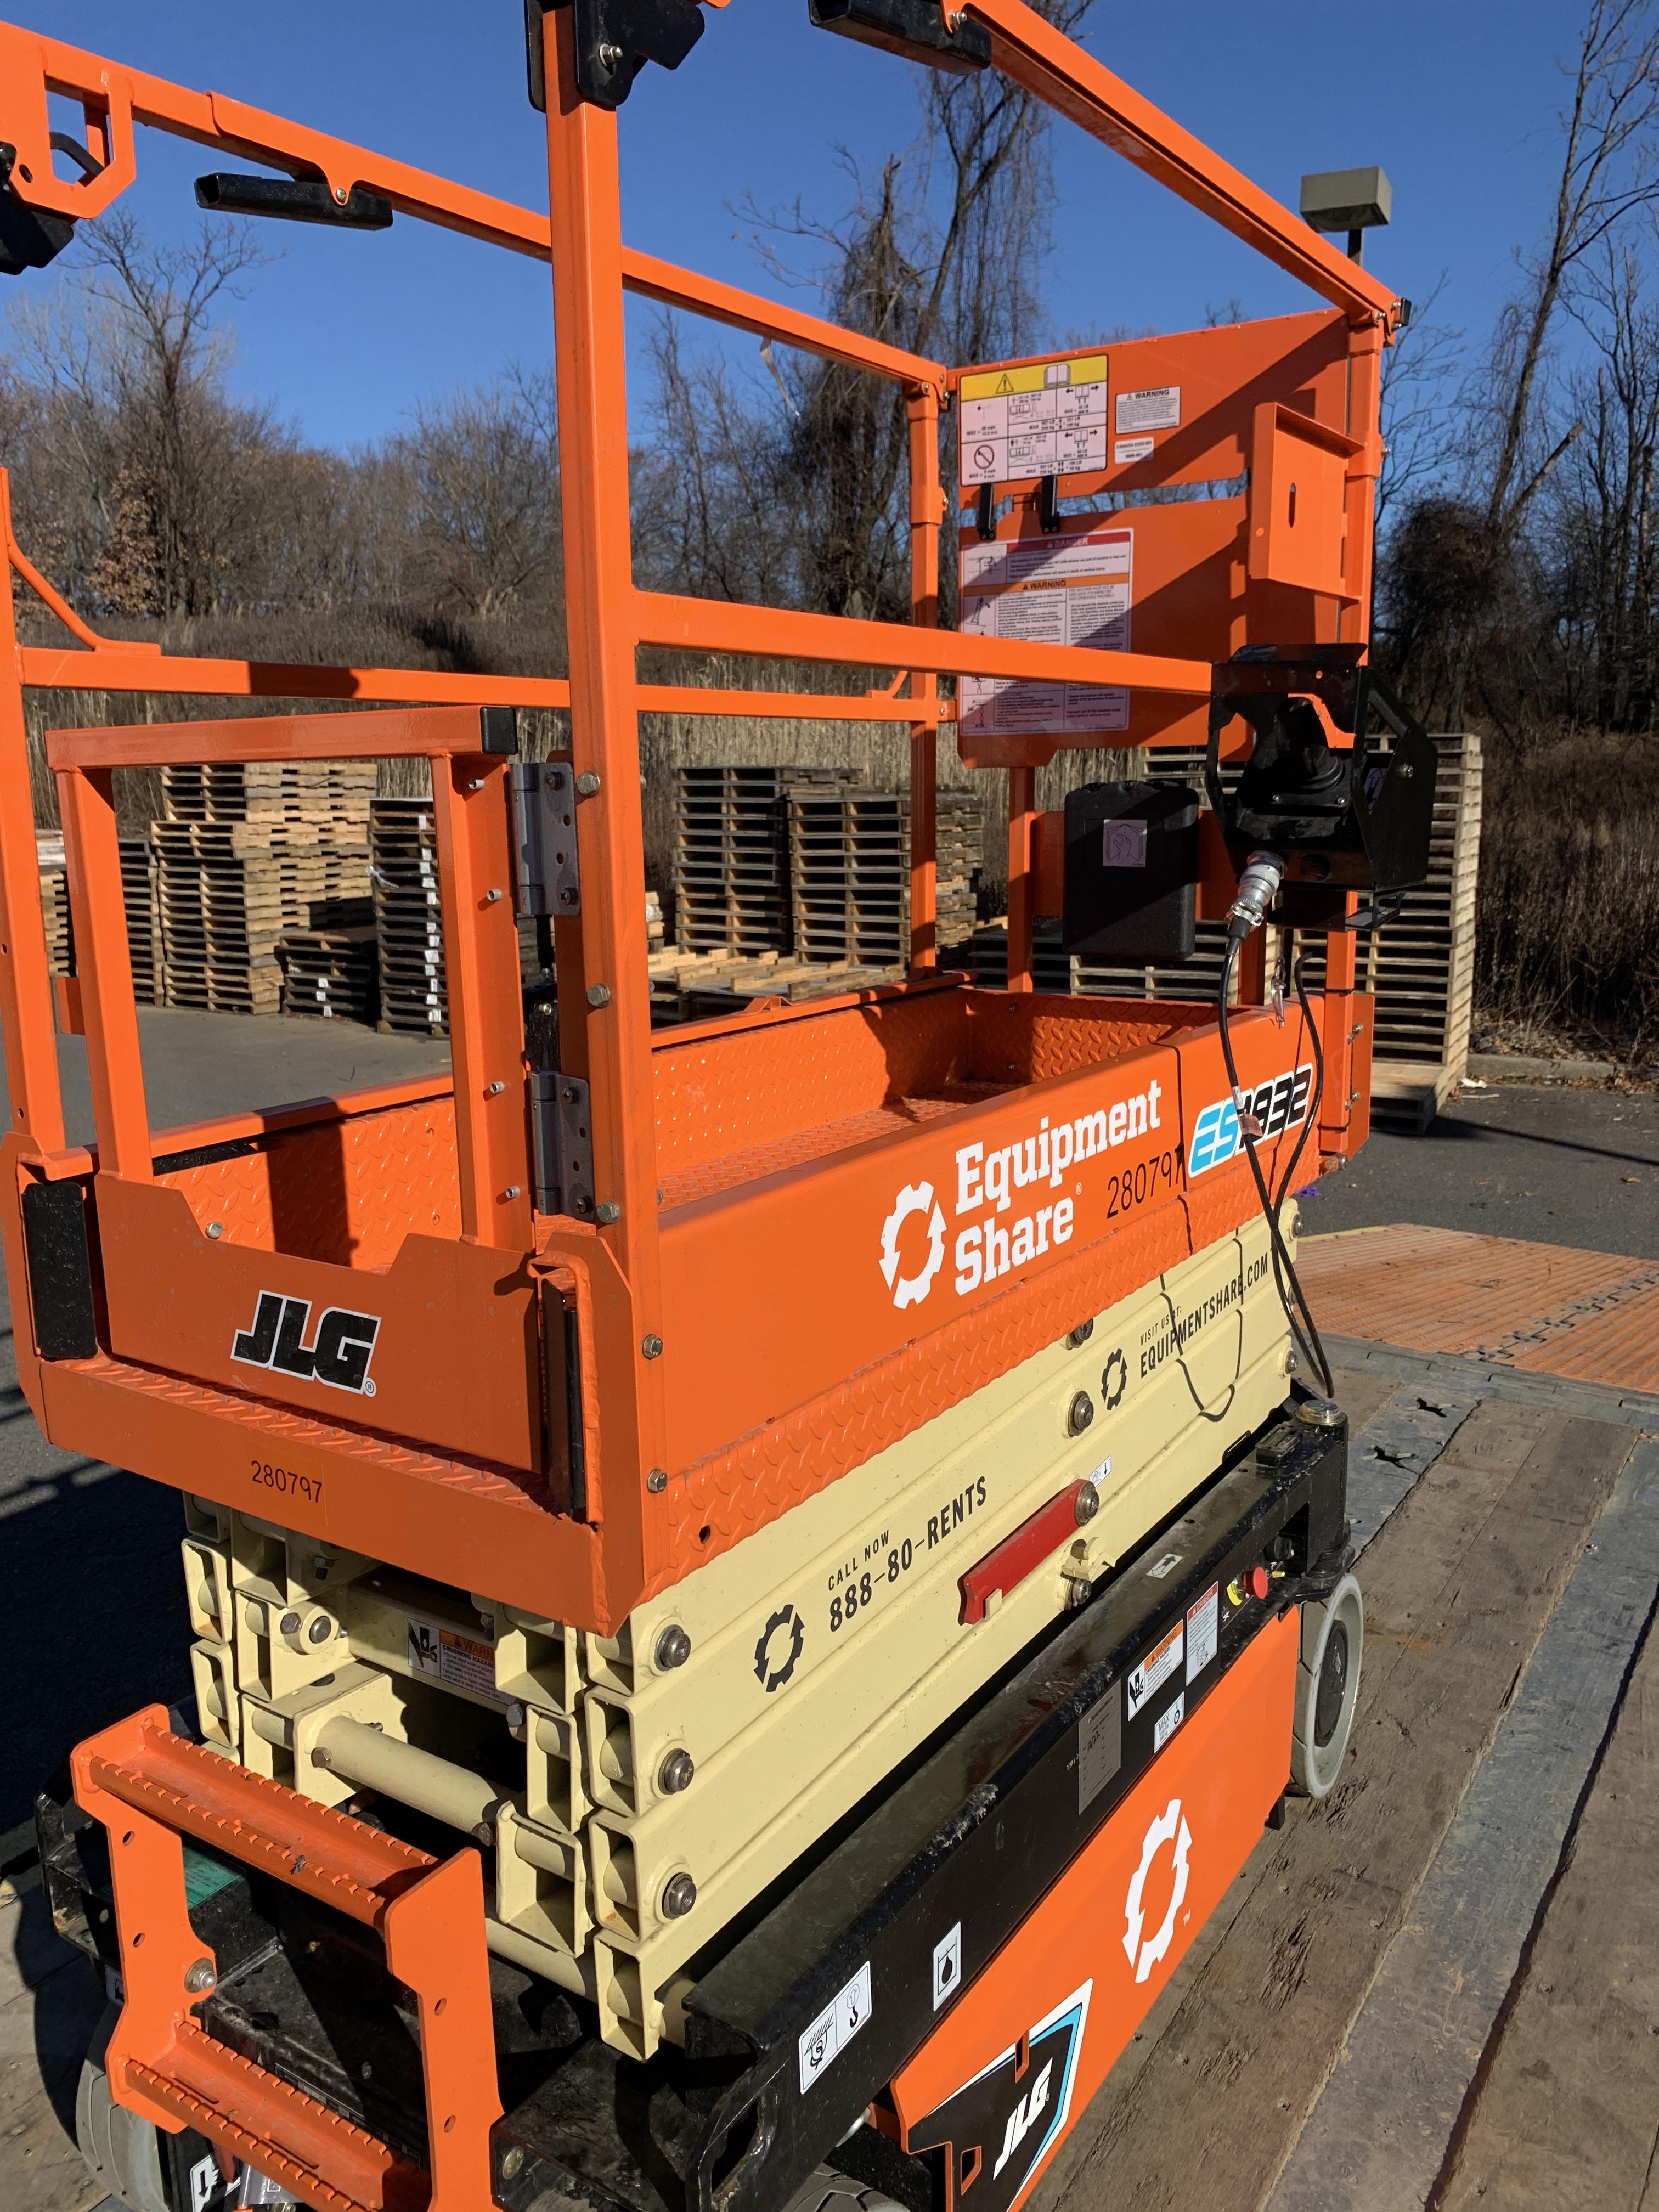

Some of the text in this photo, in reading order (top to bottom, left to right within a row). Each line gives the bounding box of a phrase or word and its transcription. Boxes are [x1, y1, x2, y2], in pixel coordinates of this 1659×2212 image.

[1135, 390, 1169, 399] WARNING
[1055, 538, 1088, 548] DANGER
[1030, 580, 1066, 590] WARNING
[955, 1079, 1161, 1215] Equipment
[1107, 1143, 1183, 1219] 280797
[955, 1197, 1074, 1296] Share
[1140, 1323, 1158, 1346] VISIT
[1161, 1314, 1169, 1329] US
[1141, 1252, 1268, 1379] EQUIPMENTSHARE.COM
[230, 1290, 382, 1395] JLG
[251, 1460, 323, 1503] 280797
[828, 1529, 890, 1591] CALL NOW
[830, 1476, 988, 1632] 888-80-RENTS
[443, 1645, 471, 1659] CRUSHING
[464, 1640, 495, 1662] WARN
[1159, 1713, 1169, 1732] MAX
[993, 2057, 1053, 2180] JLG
